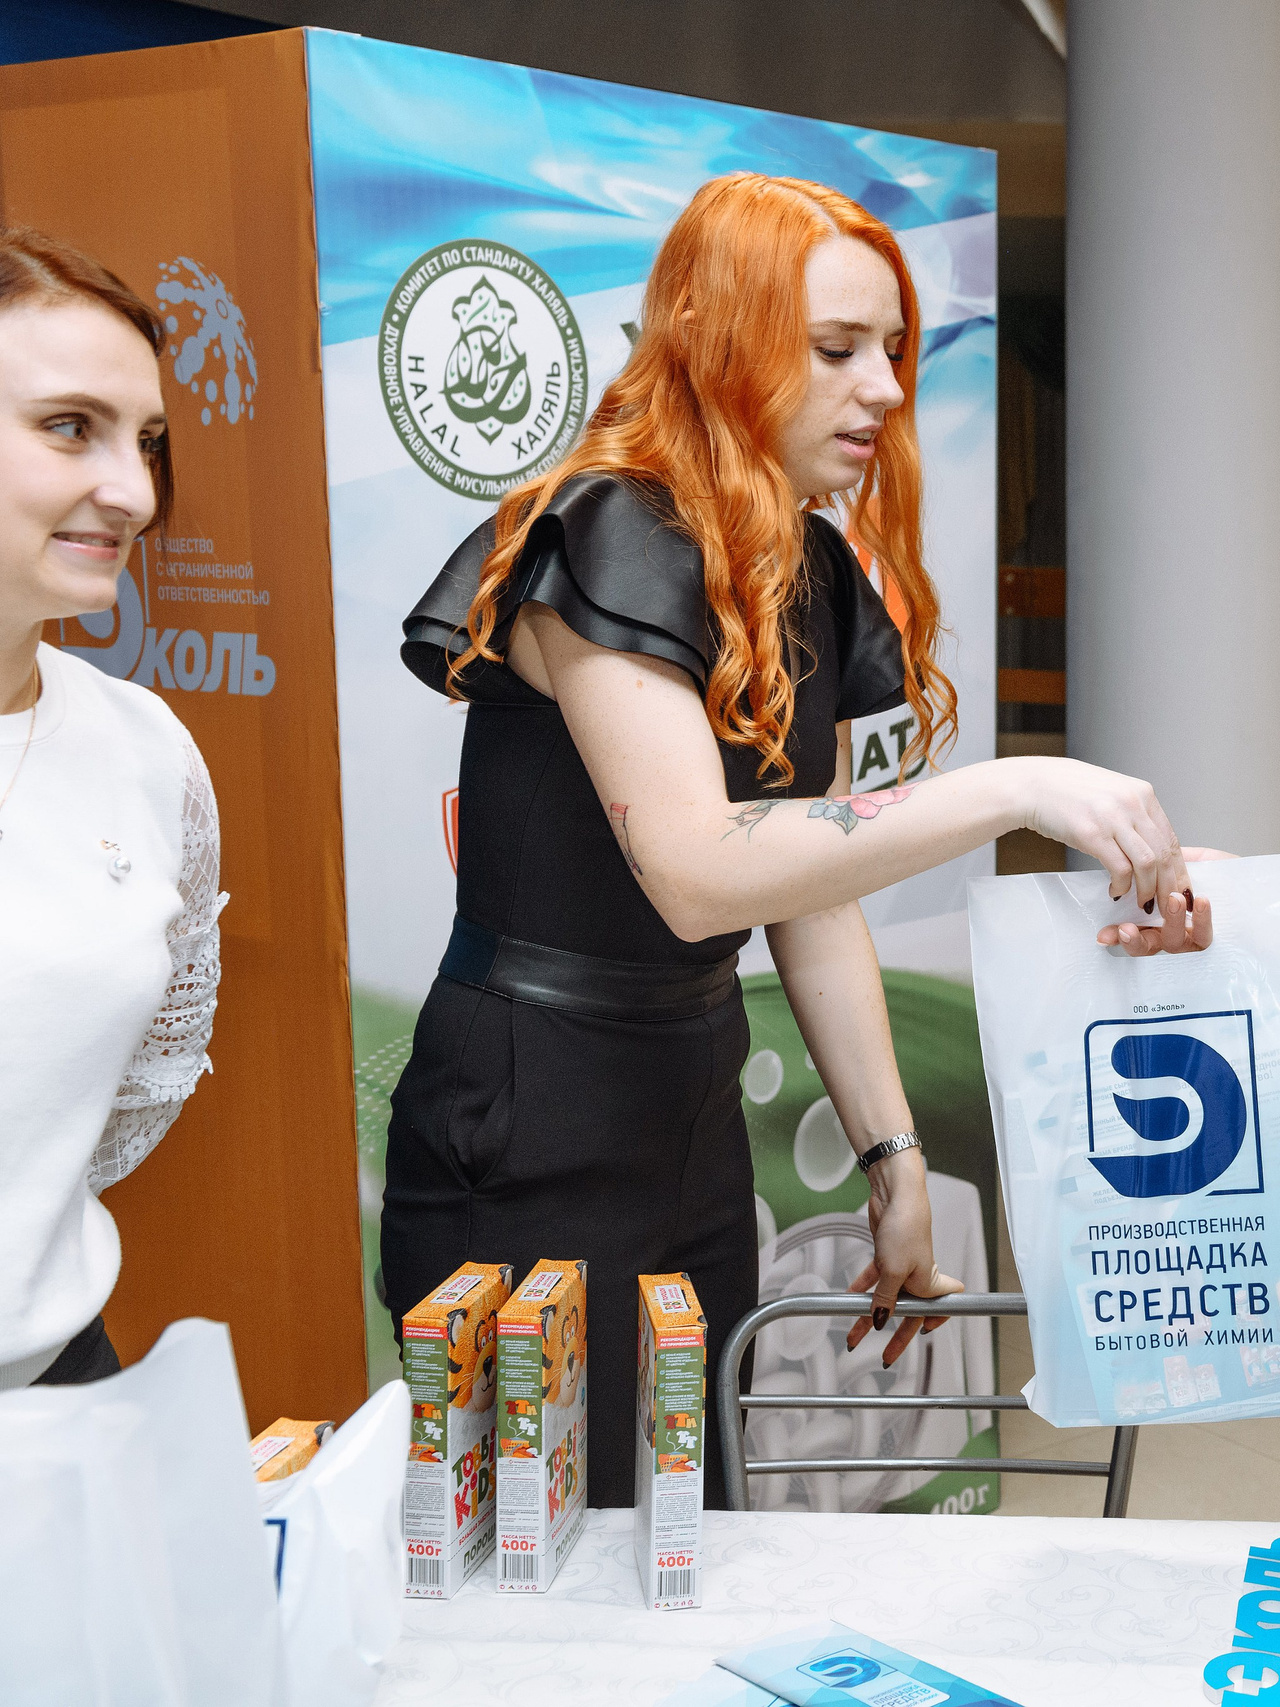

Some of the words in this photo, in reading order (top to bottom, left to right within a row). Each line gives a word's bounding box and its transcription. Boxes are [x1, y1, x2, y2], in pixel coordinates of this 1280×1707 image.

[394, 256, 442, 315] КОМИТЕТ
[443, 249, 462, 266] ПО
[462, 246, 535, 281] СТАНДАРТУ
[530, 273, 570, 328] ХАЛЯЛЬ
[383, 322, 402, 407] ДУХОВНОЕ
[566, 337, 586, 416] ТАТАРСТАН
[407, 355, 461, 458] HALAL
[510, 361, 561, 460] ХАЛЯЛЬ
[392, 406, 456, 484] УПРАВЛЕНИЕ
[166, 561, 254, 580] ОГРАНИЧЕННОЙ
[157, 585, 270, 605] ОТВЕТСТВЕННОСТЬЮ
[850, 717, 915, 783] АТ
[1133, 1005, 1149, 1013] ООО
[1088, 1216, 1266, 1240] ПРОИЗВОДСТВЕННАЯ
[1091, 1241, 1268, 1276] ПЛОЩАДКА
[1094, 1282, 1270, 1326] СРЕДСТВ
[1095, 1328, 1189, 1351] БЫТОВОЙ
[1204, 1327, 1274, 1346] ХИМИИ
[407, 1543, 442, 1556] 400г
[463, 1522, 497, 1568] ПОРОШ
[501, 1539, 537, 1552] 400г
[657, 1555, 694, 1568] 400г
